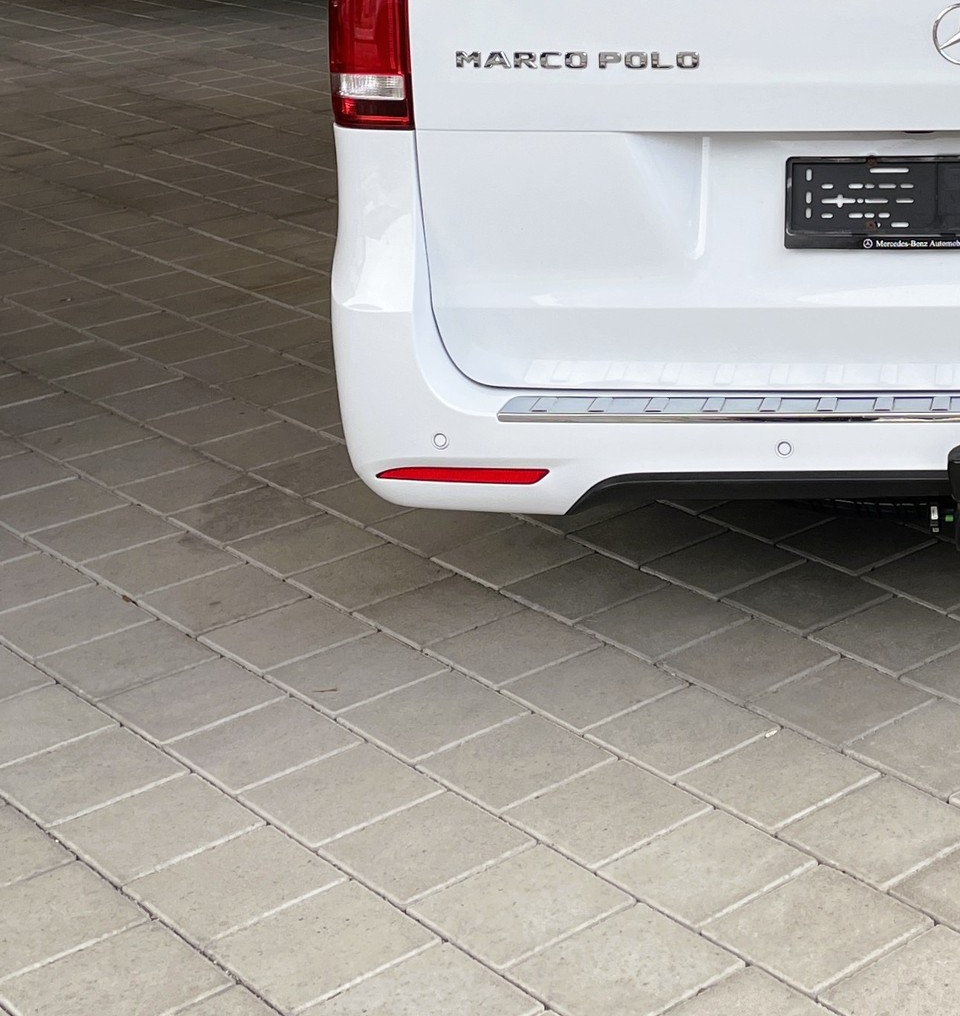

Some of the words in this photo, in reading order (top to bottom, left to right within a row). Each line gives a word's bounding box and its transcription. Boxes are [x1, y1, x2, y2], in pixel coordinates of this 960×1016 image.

[455, 50, 589, 70] MARCO
[598, 50, 701, 70] POLO
[875, 240, 928, 248] Mercedes-Benz
